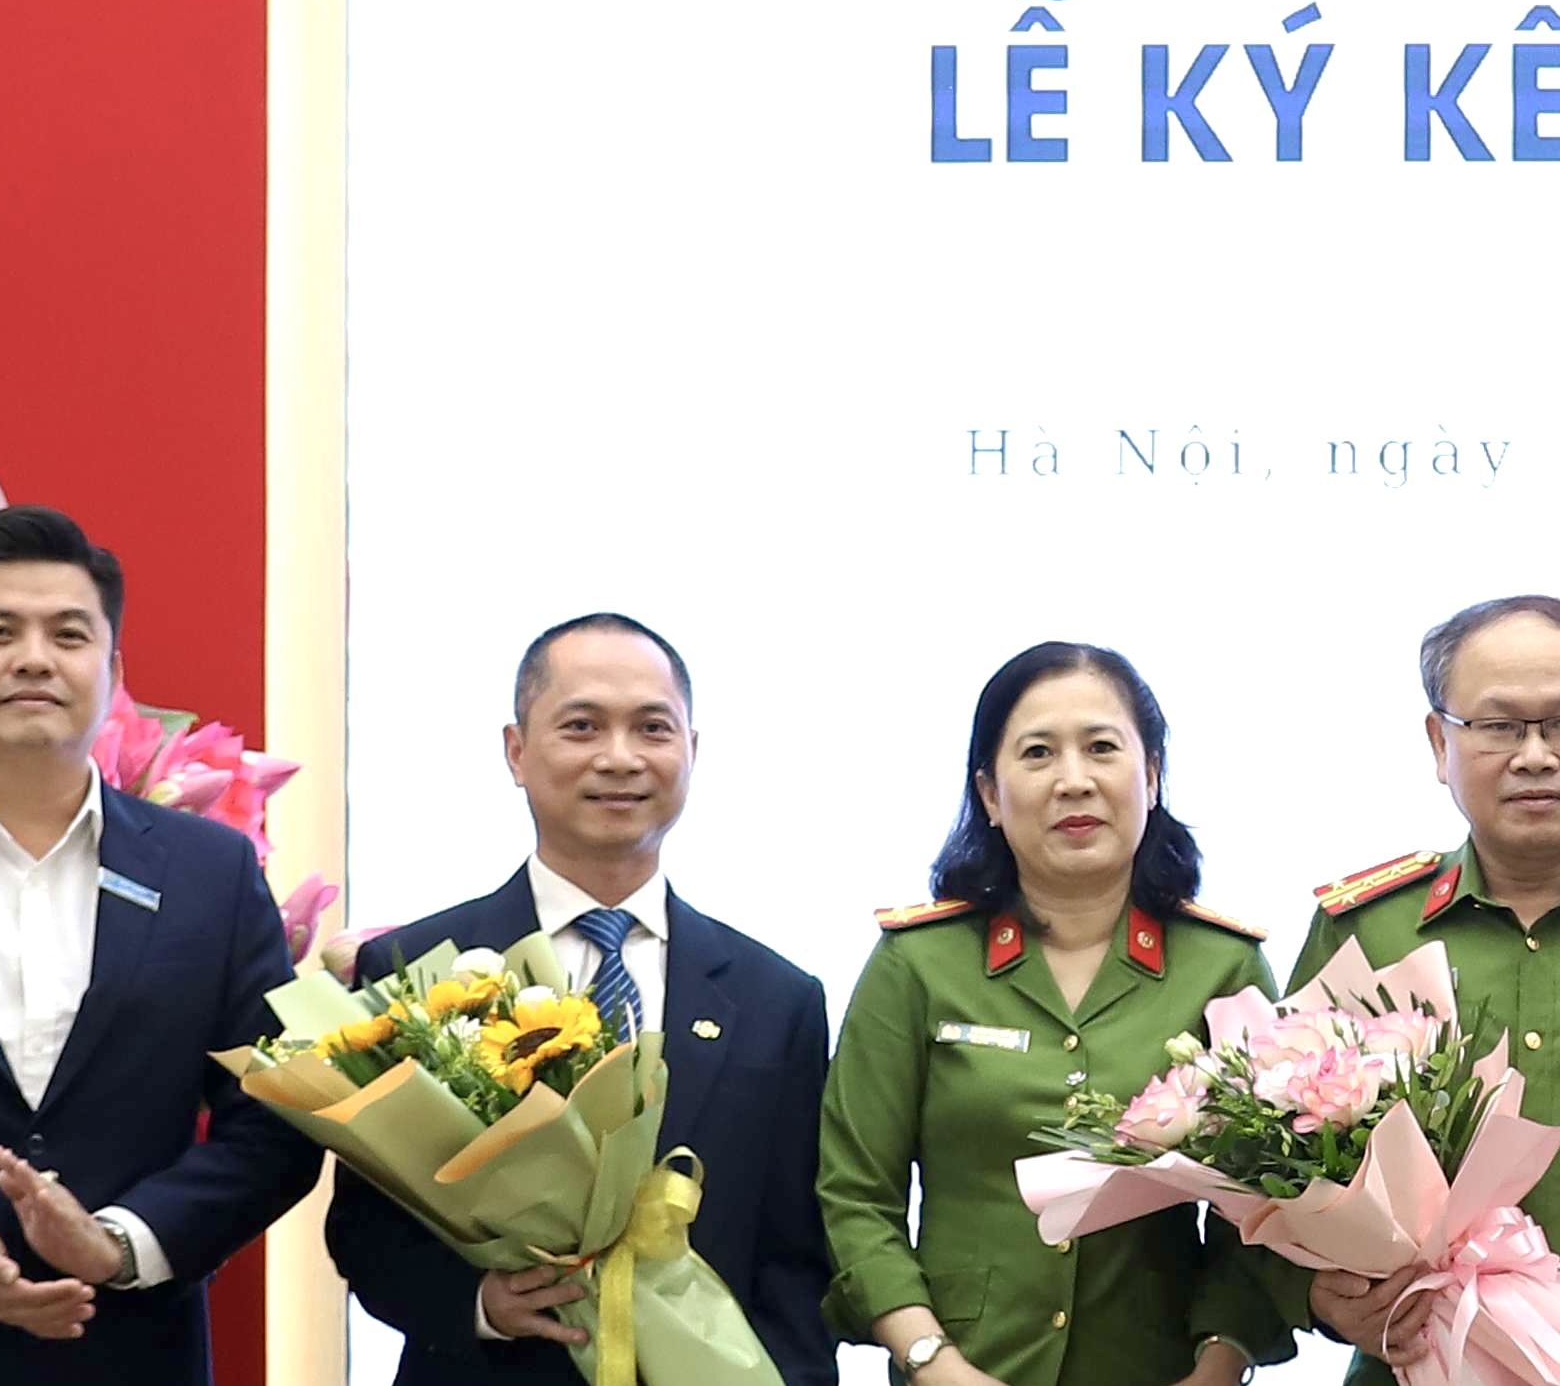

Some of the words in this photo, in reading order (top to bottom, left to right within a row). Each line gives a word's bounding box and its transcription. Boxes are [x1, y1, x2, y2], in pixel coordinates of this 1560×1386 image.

[1139, 0, 1338, 165] KÝ
[966, 425, 1060, 477] Hà
[1114, 423, 1272, 487] Nội,
[1326, 423, 1512, 489] ngày
